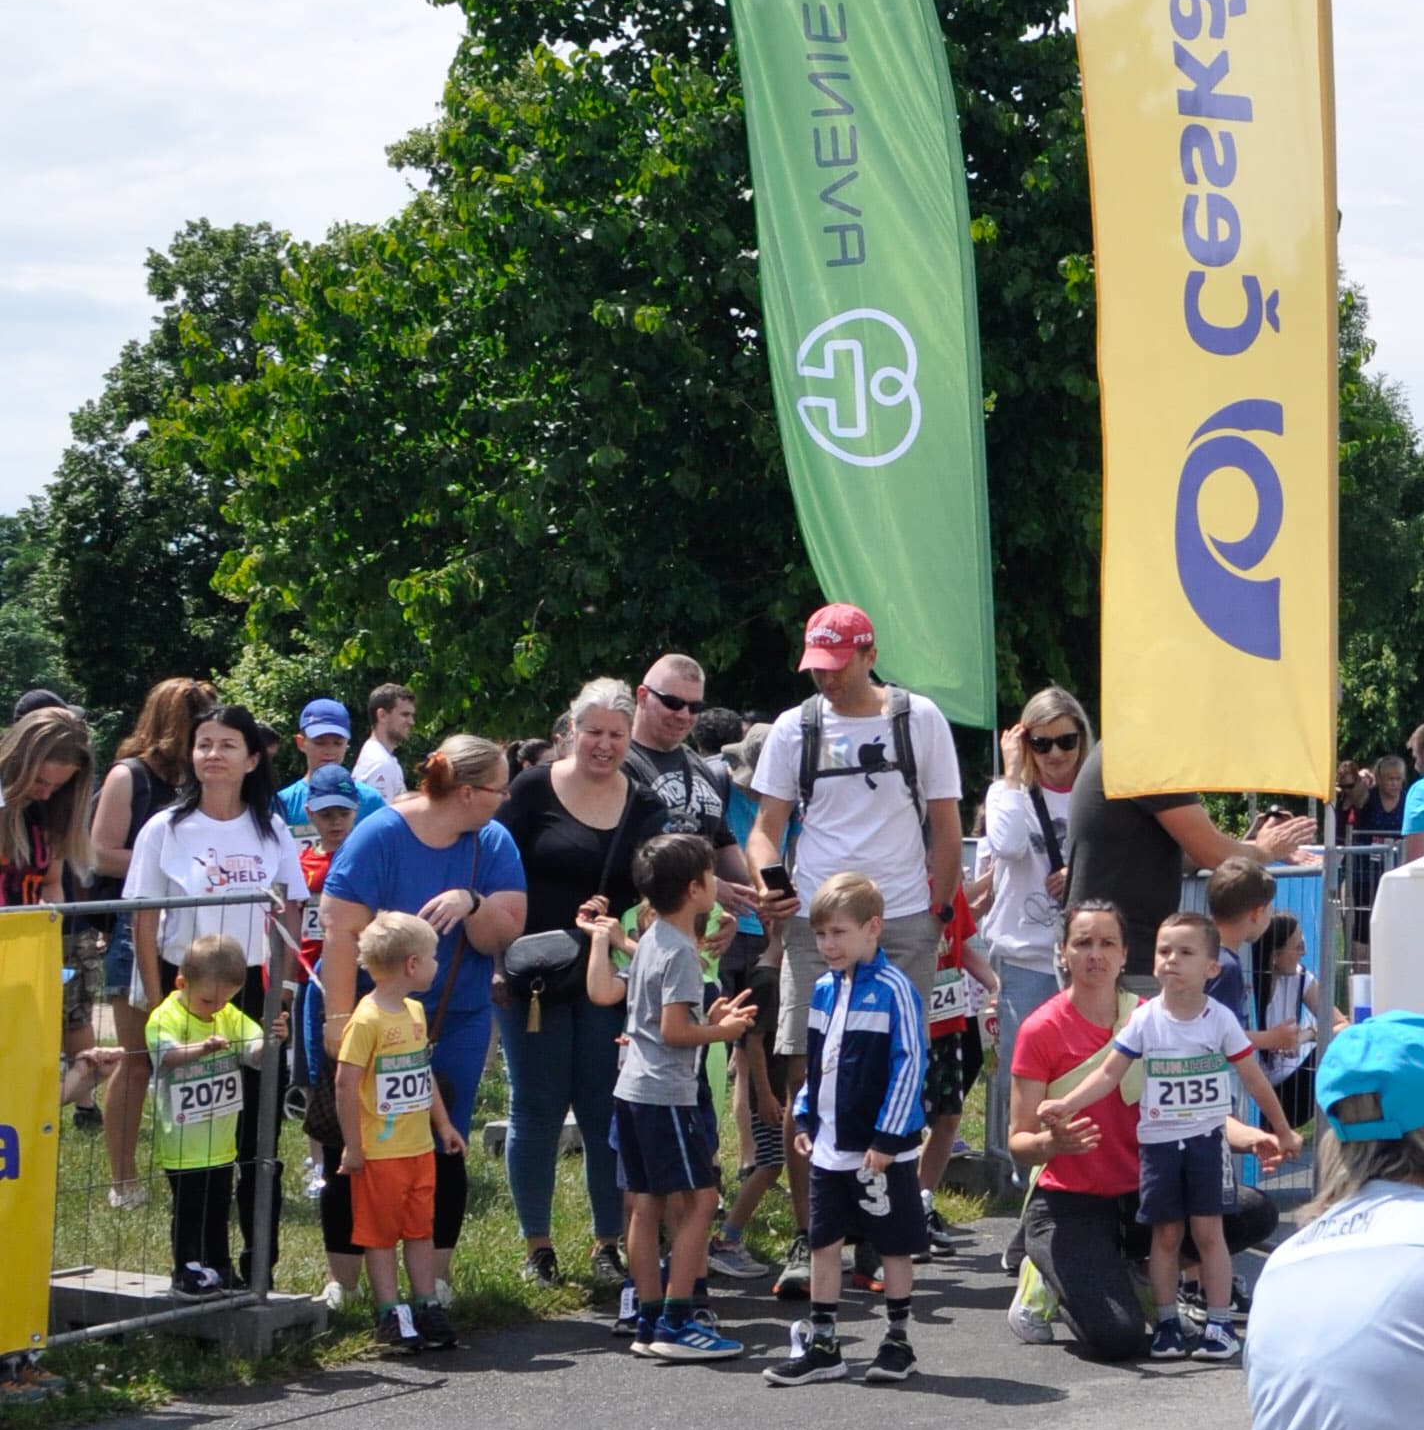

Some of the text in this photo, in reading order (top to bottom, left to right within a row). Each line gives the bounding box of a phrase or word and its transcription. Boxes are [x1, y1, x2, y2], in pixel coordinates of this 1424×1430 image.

[227, 870, 268, 883] HELP
[931, 986, 956, 1009] 24
[180, 1076, 237, 1110] 2079
[1158, 1077, 1219, 1106] 2135
[856, 1170, 891, 1217] 3
